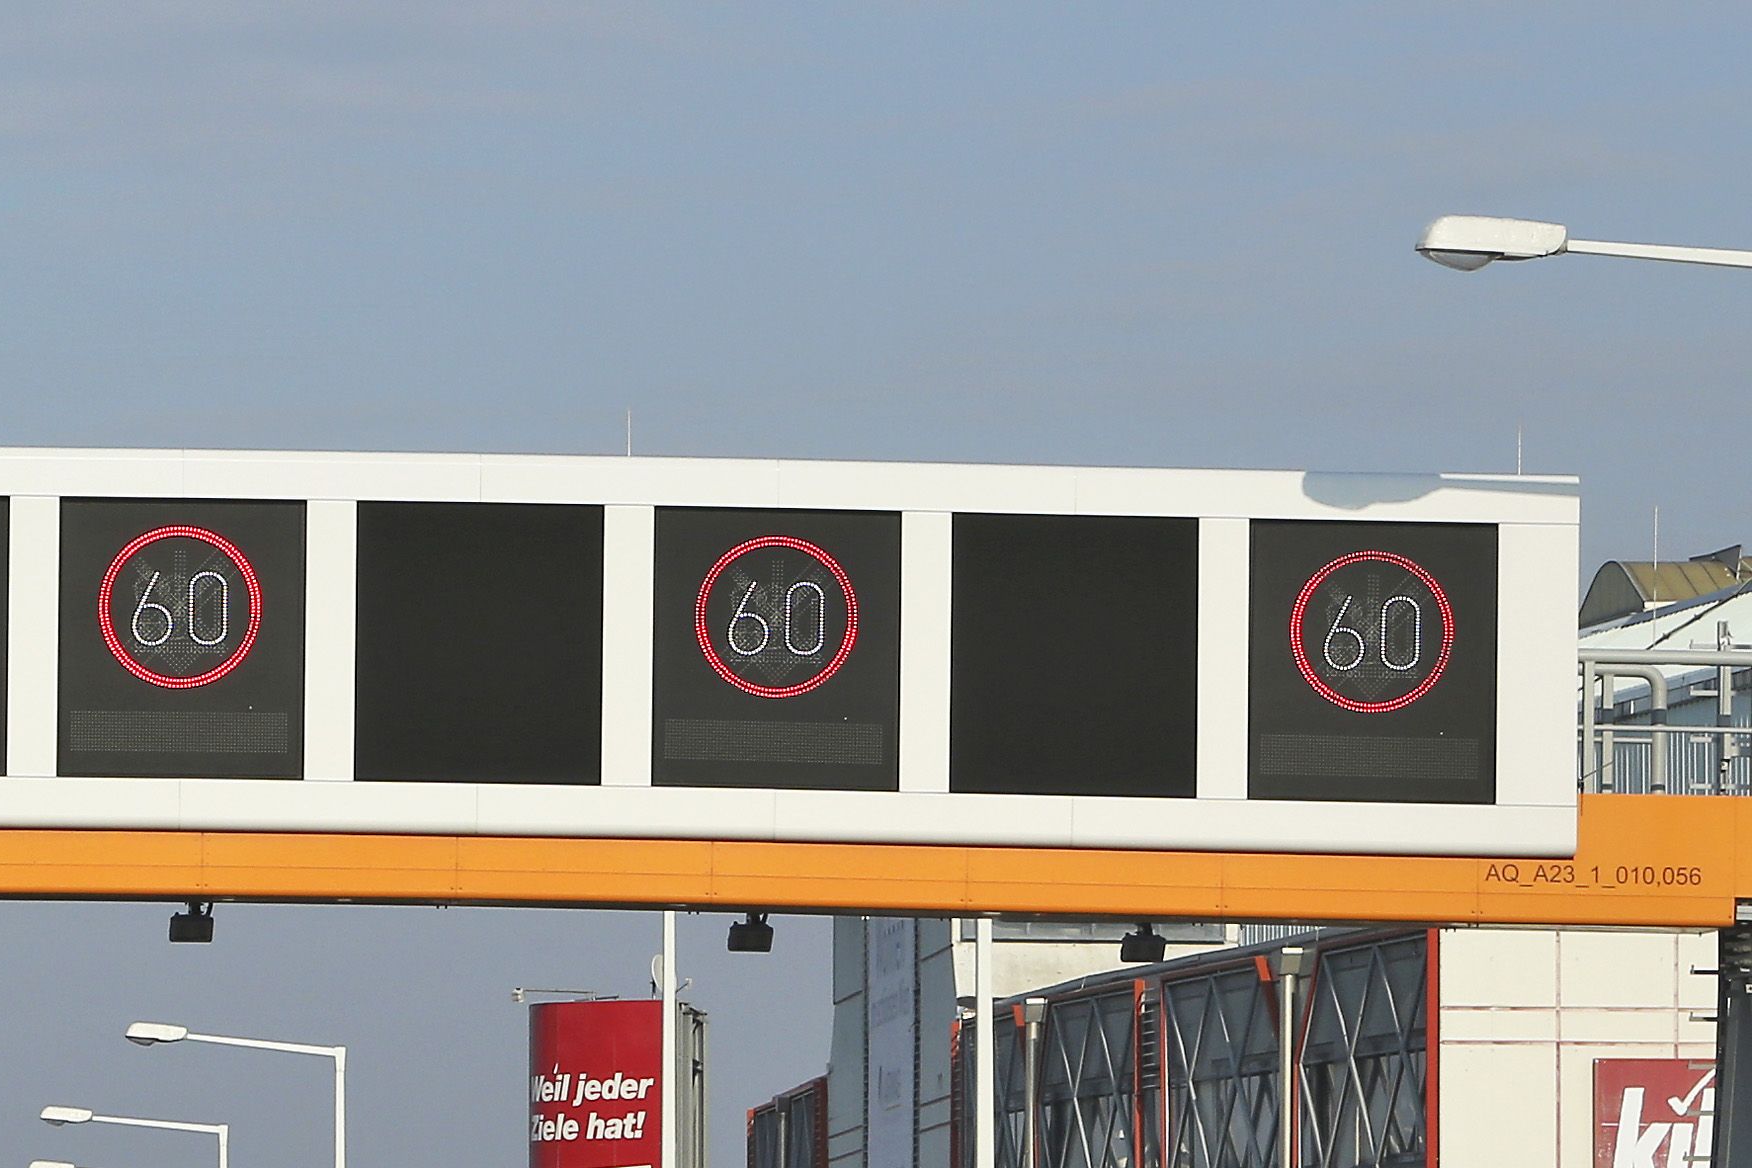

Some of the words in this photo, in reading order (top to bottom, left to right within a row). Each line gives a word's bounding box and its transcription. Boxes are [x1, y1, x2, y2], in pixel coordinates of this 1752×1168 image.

[132, 570, 229, 646] 60
[727, 580, 825, 656] 60
[1322, 594, 1421, 671] 60
[1485, 863, 1702, 889] AQ_A23_1_010,056
[573, 1072, 654, 1107] jeder
[532, 1113, 579, 1142] Ziele
[586, 1111, 647, 1140] hat!
